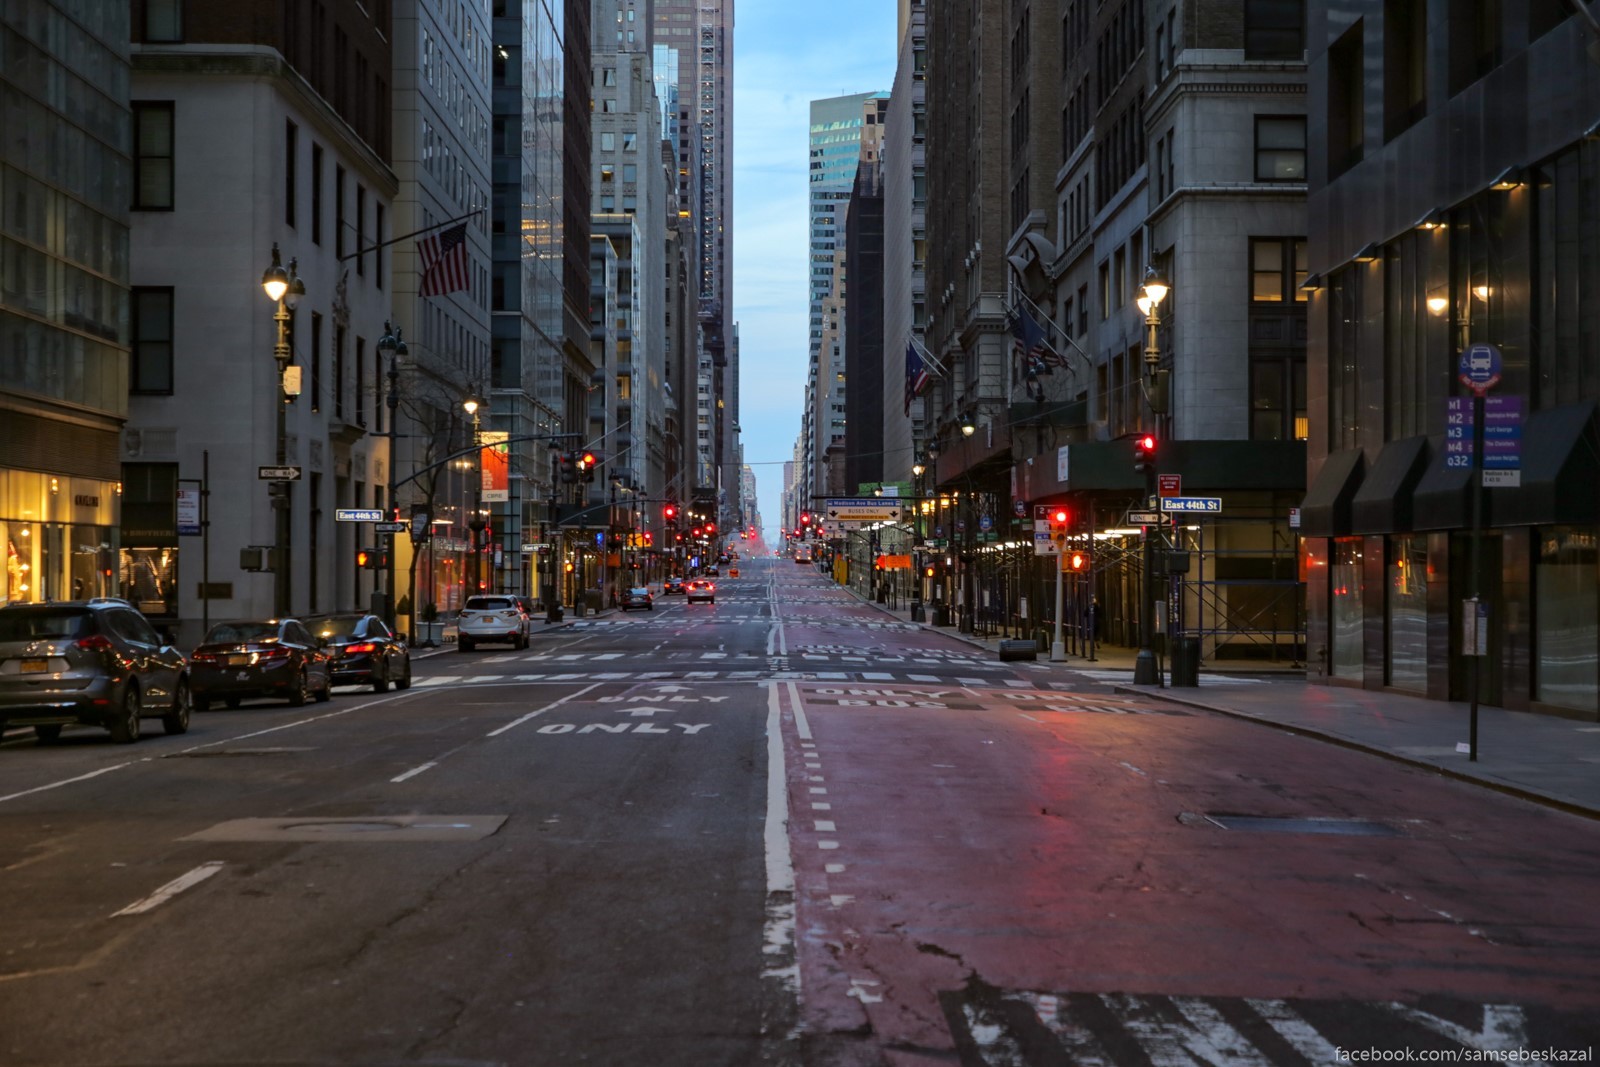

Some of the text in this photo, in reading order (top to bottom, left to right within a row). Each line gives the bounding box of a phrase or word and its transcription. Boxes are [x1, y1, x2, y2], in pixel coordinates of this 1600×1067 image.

[1449, 399, 1460, 410] M1
[1448, 413, 1462, 424] M2
[1448, 427, 1462, 438] M3
[1447, 441, 1462, 452] M4
[1447, 455, 1468, 466] Q32
[1164, 500, 1185, 509] East
[1186, 500, 1206, 510] 44th
[1207, 500, 1217, 510] St
[371, 512, 379, 520] St
[815, 688, 951, 698] ONLY
[596, 695, 730, 703] ONLY
[837, 699, 949, 709] BUS
[536, 722, 712, 735] ONLY
